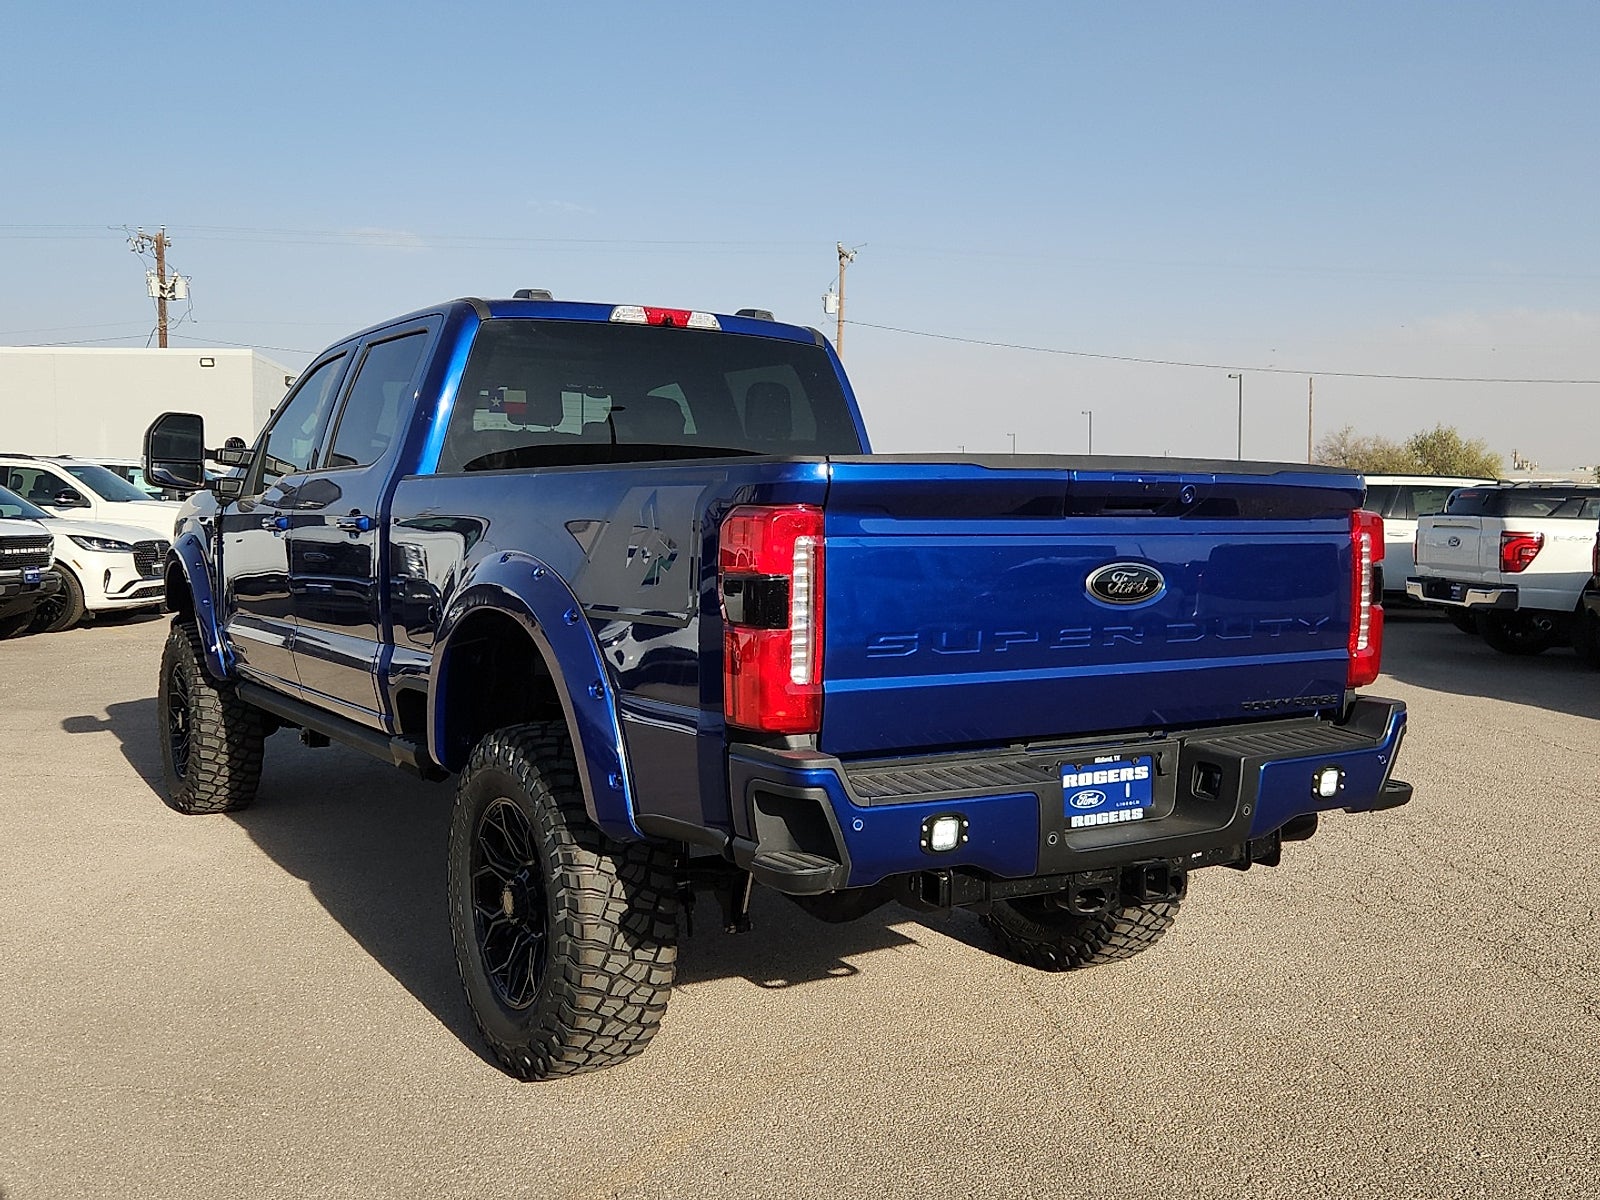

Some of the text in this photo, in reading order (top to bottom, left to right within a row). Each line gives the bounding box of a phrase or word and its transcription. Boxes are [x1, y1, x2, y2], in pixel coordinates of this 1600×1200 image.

[1107, 571, 1149, 595] Ford
[866, 616, 1330, 659] SUPER DUTY
[1062, 766, 1149, 788] ROGERS
[1076, 792, 1099, 806] Ford
[1071, 808, 1144, 828] ROGERS
